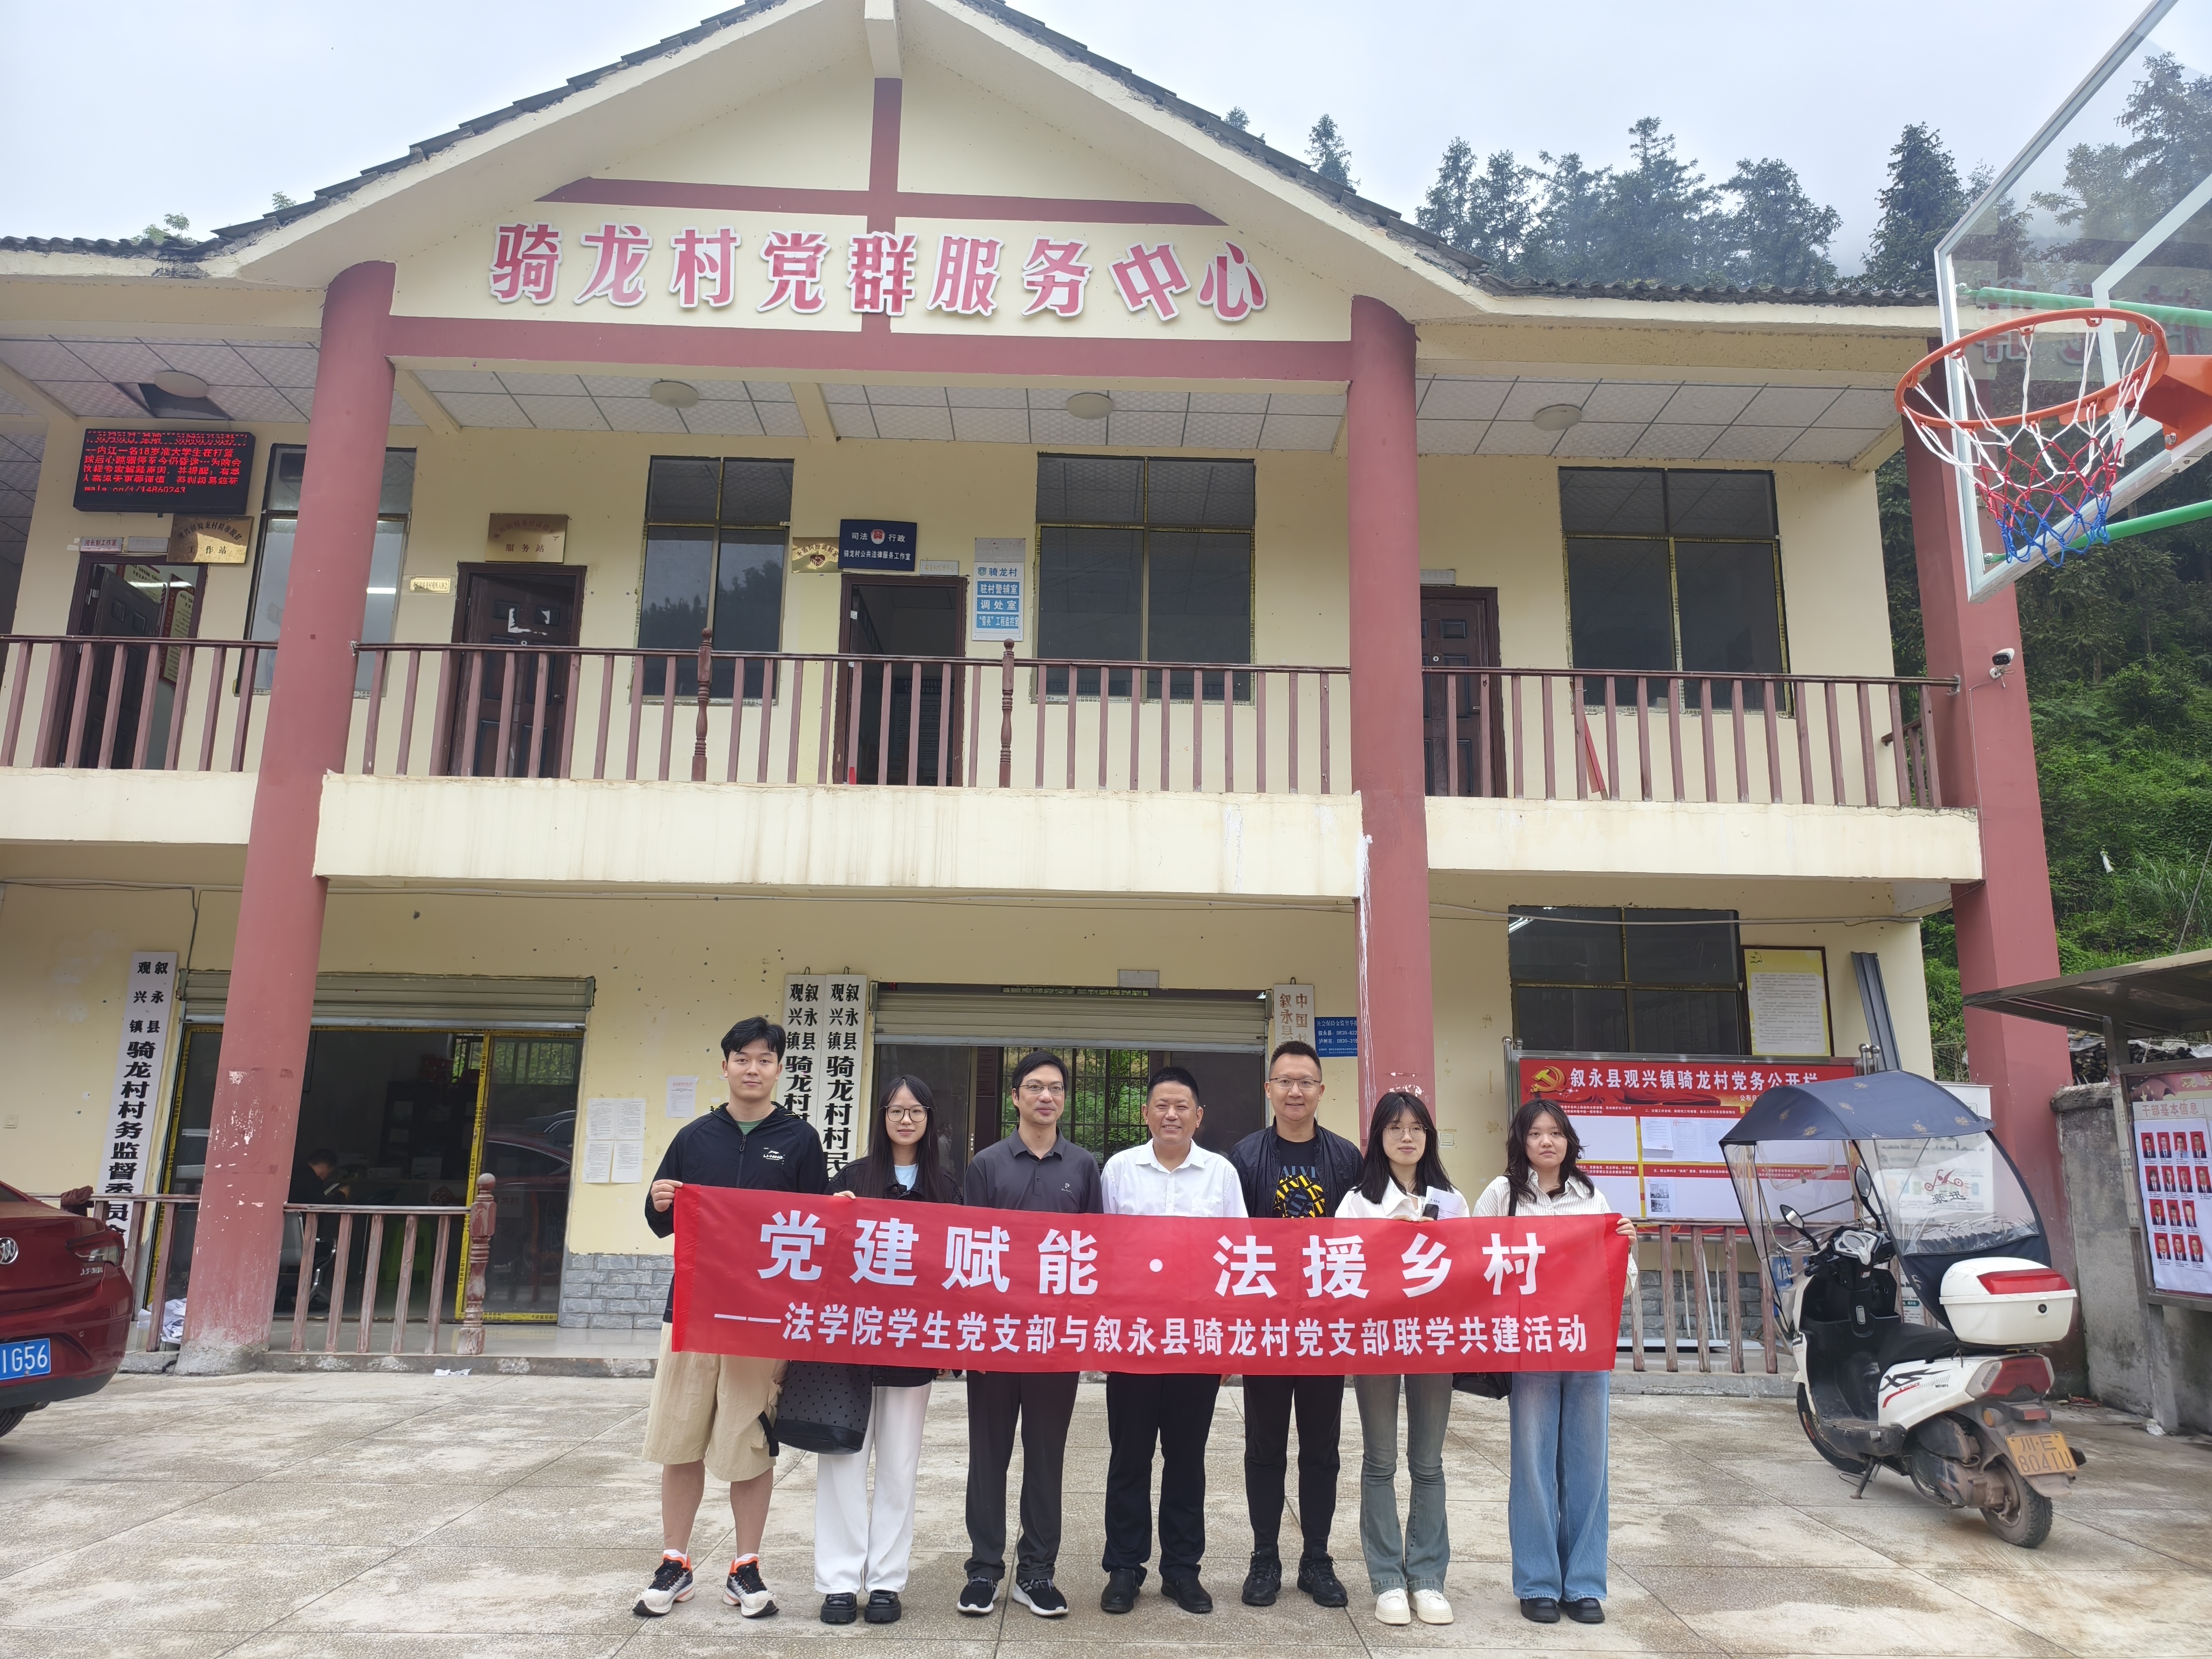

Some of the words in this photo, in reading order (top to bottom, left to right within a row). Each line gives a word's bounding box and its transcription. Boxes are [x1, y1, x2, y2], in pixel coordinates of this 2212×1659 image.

[489, 221, 1267, 321] 骑龙村党群服务中心
[188, 545, 227, 555] 工作站
[505, 544, 545, 552] 服务站
[844, 549, 911, 561] 骑龙村公共法律服务工作室
[851, 532, 868, 541] 司法
[888, 534, 906, 543] 行政
[980, 583, 1018, 595] 驻村警辅室
[989, 567, 1017, 577] 骑龙村
[980, 599, 1017, 611] 调处室
[129, 961, 152, 1034] 观兴镇
[147, 961, 169, 1034] 叙永县
[786, 983, 803, 1051] 观兴镇
[801, 983, 819, 1051] 叙永县
[827, 983, 845, 1051] 观兴镇
[842, 983, 860, 1051] 叙永县
[1279, 993, 1294, 1043] 叙永县
[784, 1055, 813, 1124] 骑龙村
[2142, 1102, 2198, 1117] 干部基本信息
[757, 1210, 1546, 1299] 党建赋能·法援乡村
[714, 1302, 1587, 1357] ——法学院学生党支部与叙永县骑龙村党支部联学共建活动
[2020, 1435, 2057, 1452] 川·E
